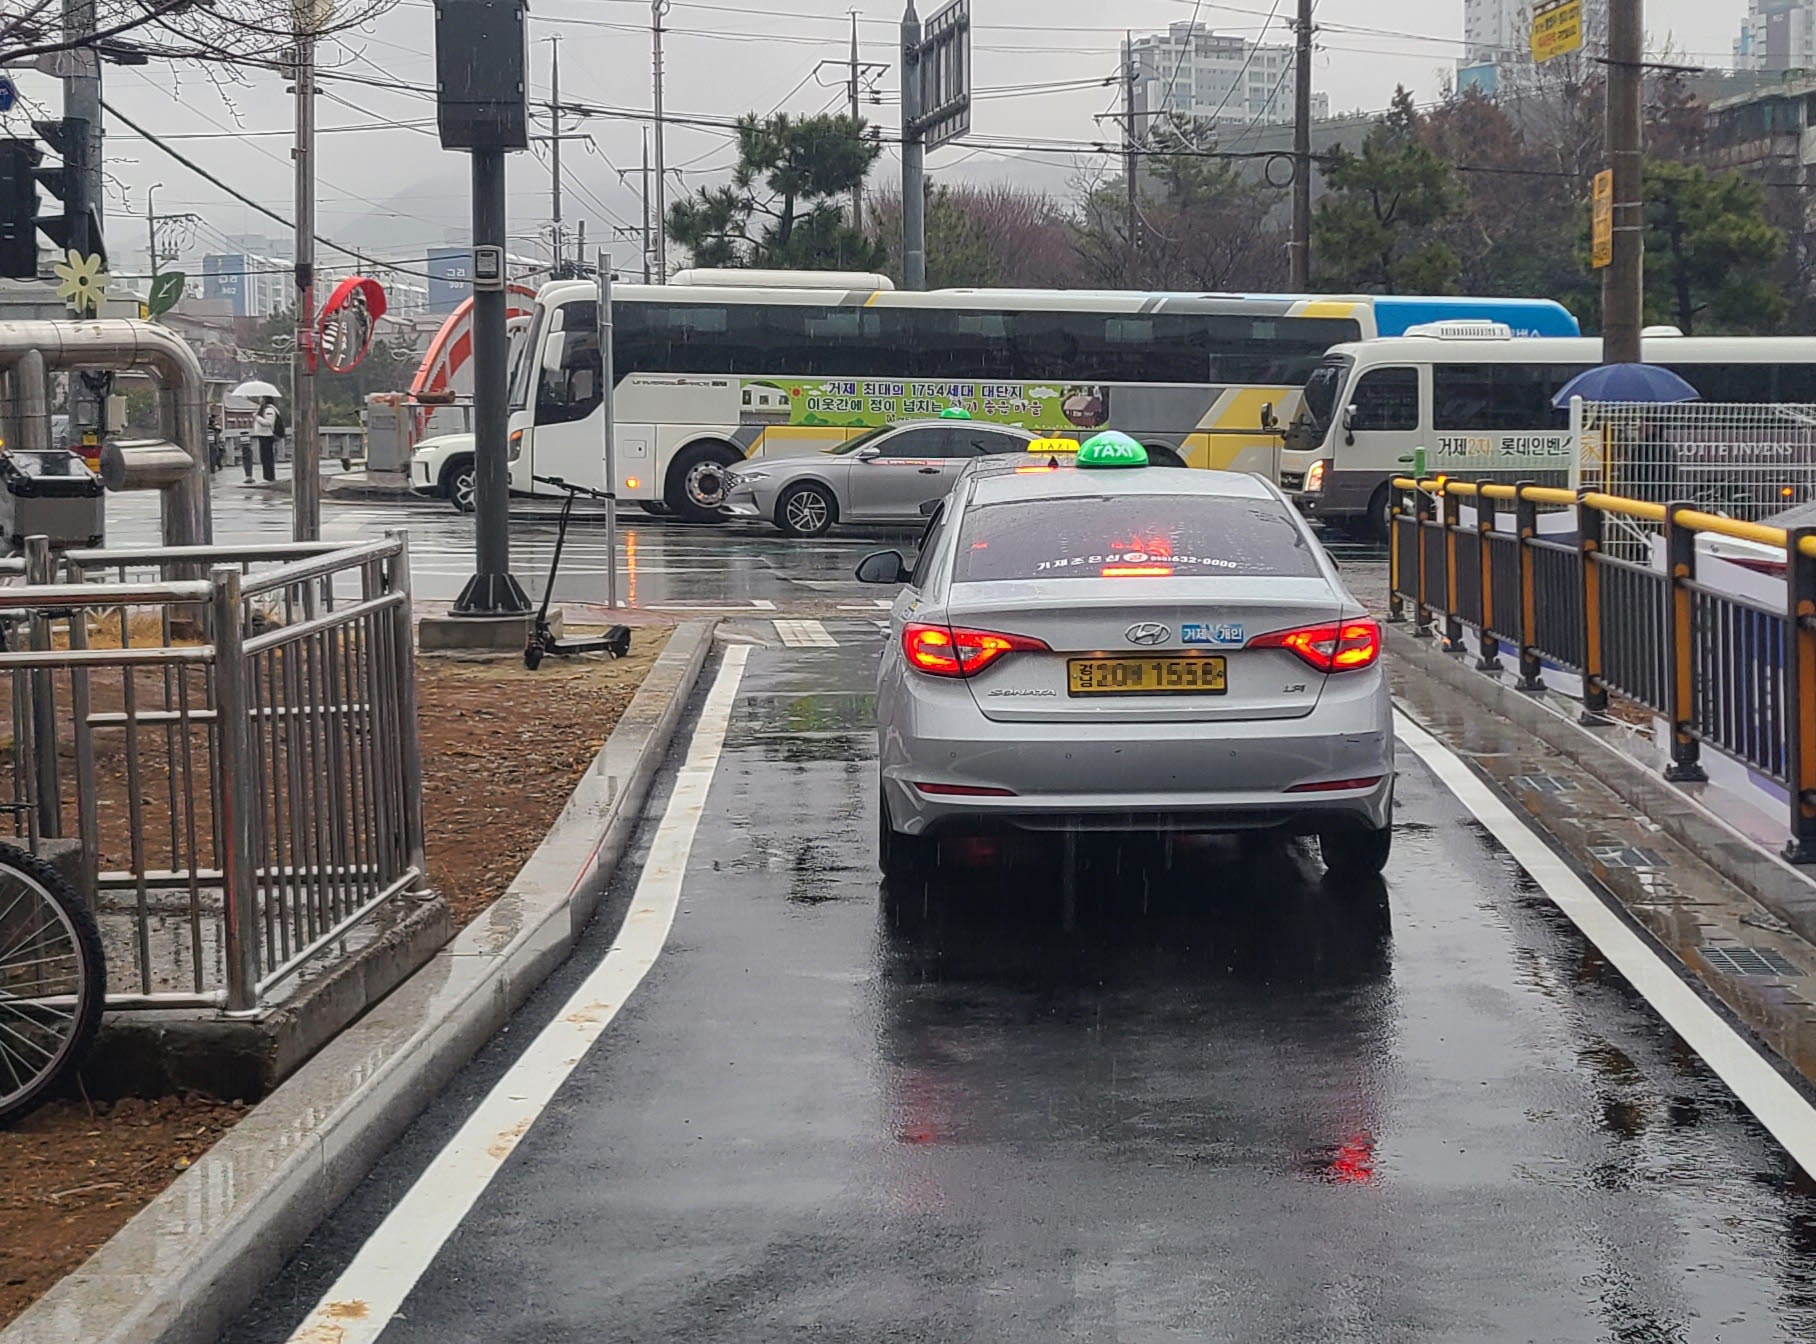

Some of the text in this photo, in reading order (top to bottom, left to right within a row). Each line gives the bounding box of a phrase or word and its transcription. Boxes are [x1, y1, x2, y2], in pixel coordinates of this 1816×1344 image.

[829, 382, 1023, 399] 거제 최대의 1754세대 대단지
[807, 397, 863, 412] 이웃간에
[870, 399, 896, 413] 정이
[903, 400, 942, 413] 넘치는
[1040, 442, 1070, 450] TAXI
[1093, 445, 1132, 458] TAXI
[1183, 628, 1242, 640] 거제 개인
[987, 689, 1057, 697] SONATA
